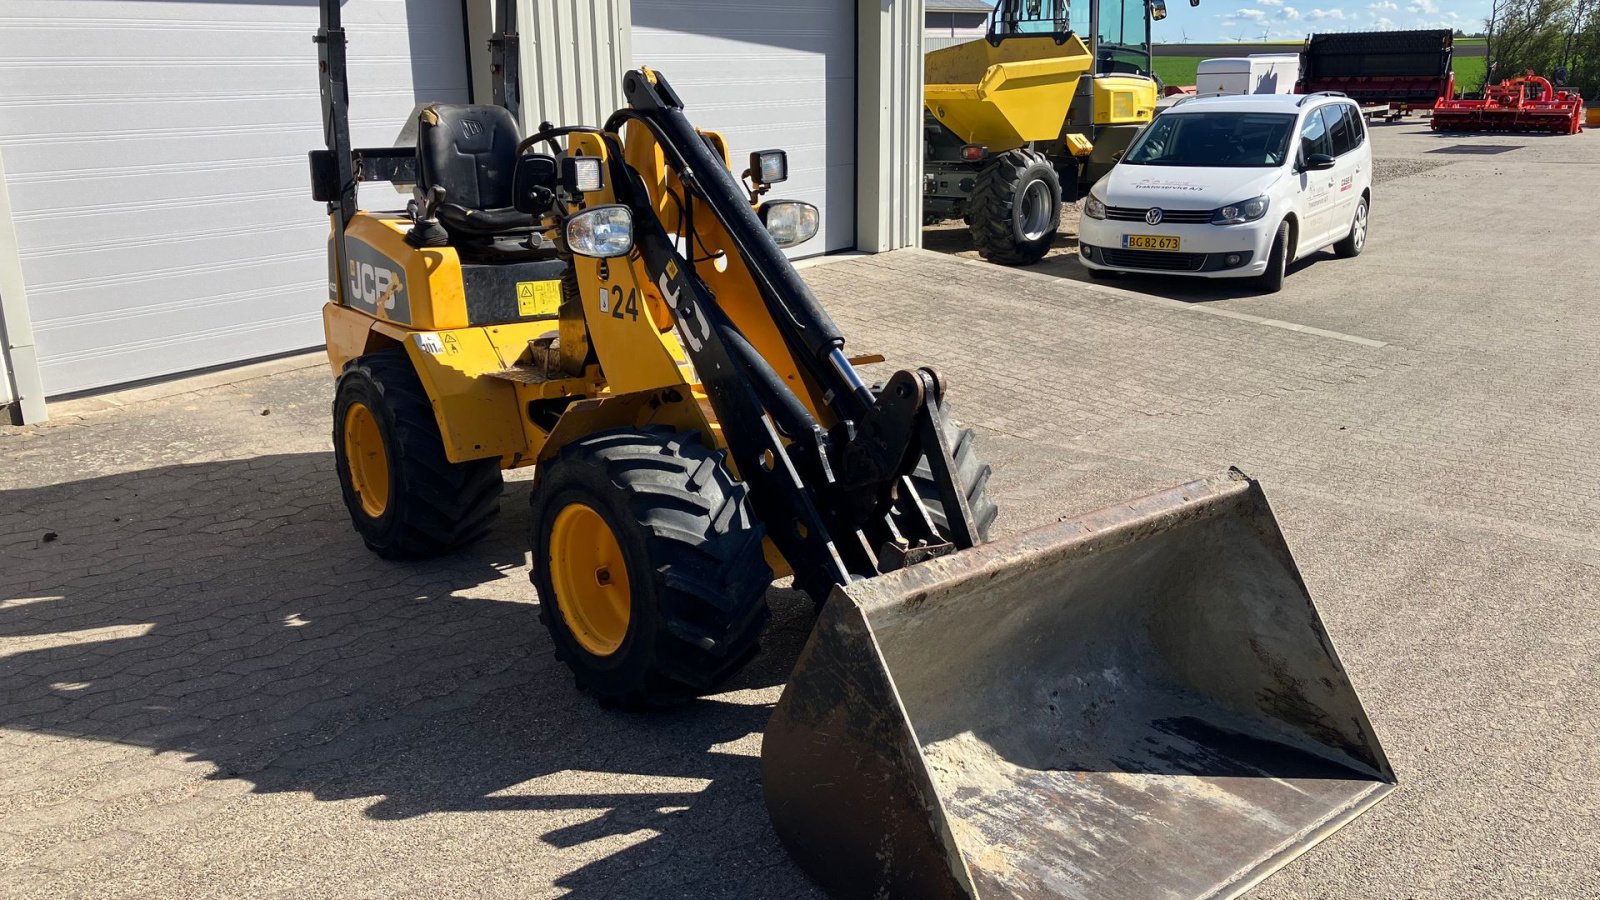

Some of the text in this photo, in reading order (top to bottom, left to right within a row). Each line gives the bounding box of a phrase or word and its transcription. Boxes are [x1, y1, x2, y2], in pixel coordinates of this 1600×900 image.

[1129, 237, 1178, 249] BG 82 673
[350, 260, 396, 310] JCB
[611, 284, 639, 322] 24
